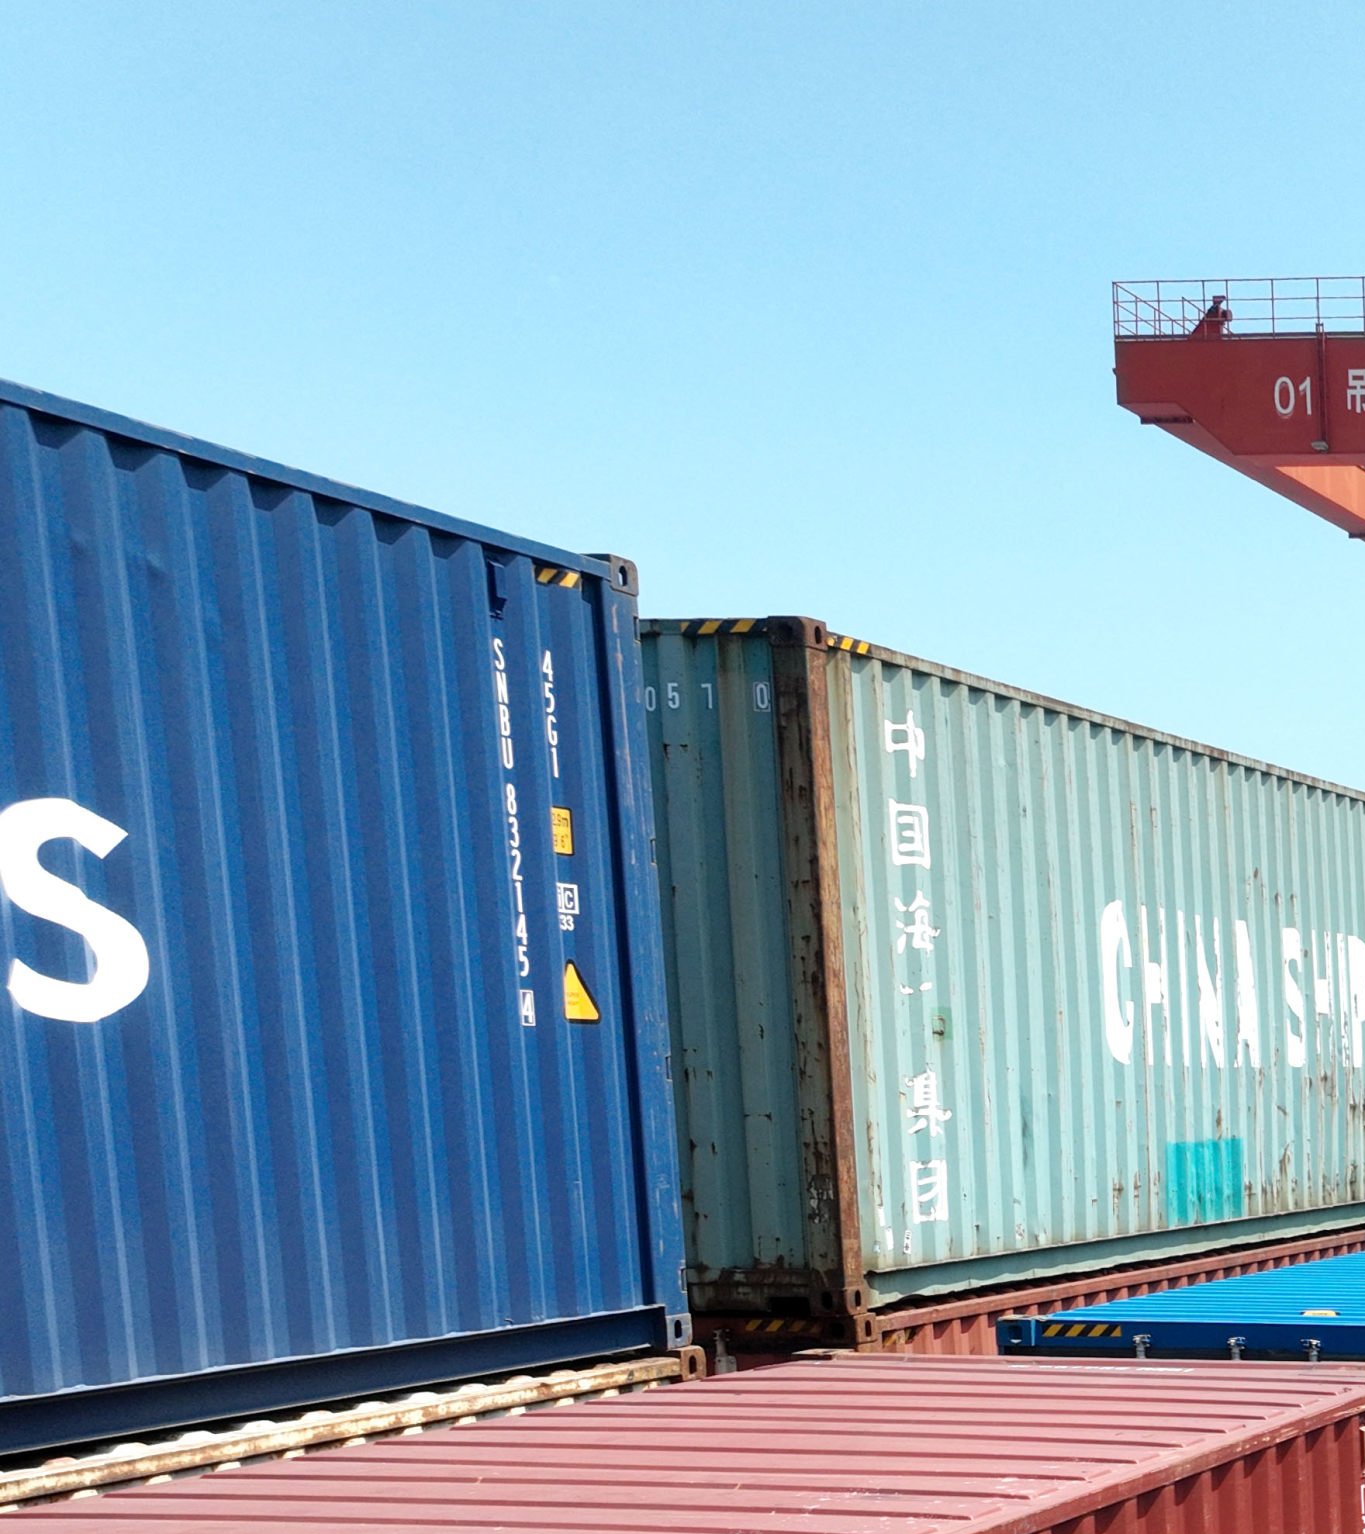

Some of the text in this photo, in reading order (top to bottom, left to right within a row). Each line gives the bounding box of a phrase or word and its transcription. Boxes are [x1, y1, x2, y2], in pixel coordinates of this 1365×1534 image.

[1273, 376, 1312, 416] 01
[492, 638, 513, 770] SNBU
[542, 650, 558, 778] 45G1
[0, 797, 150, 1023] S
[506, 783, 534, 1025] 832145 4
[1100, 900, 1261, 1070] CHINA
